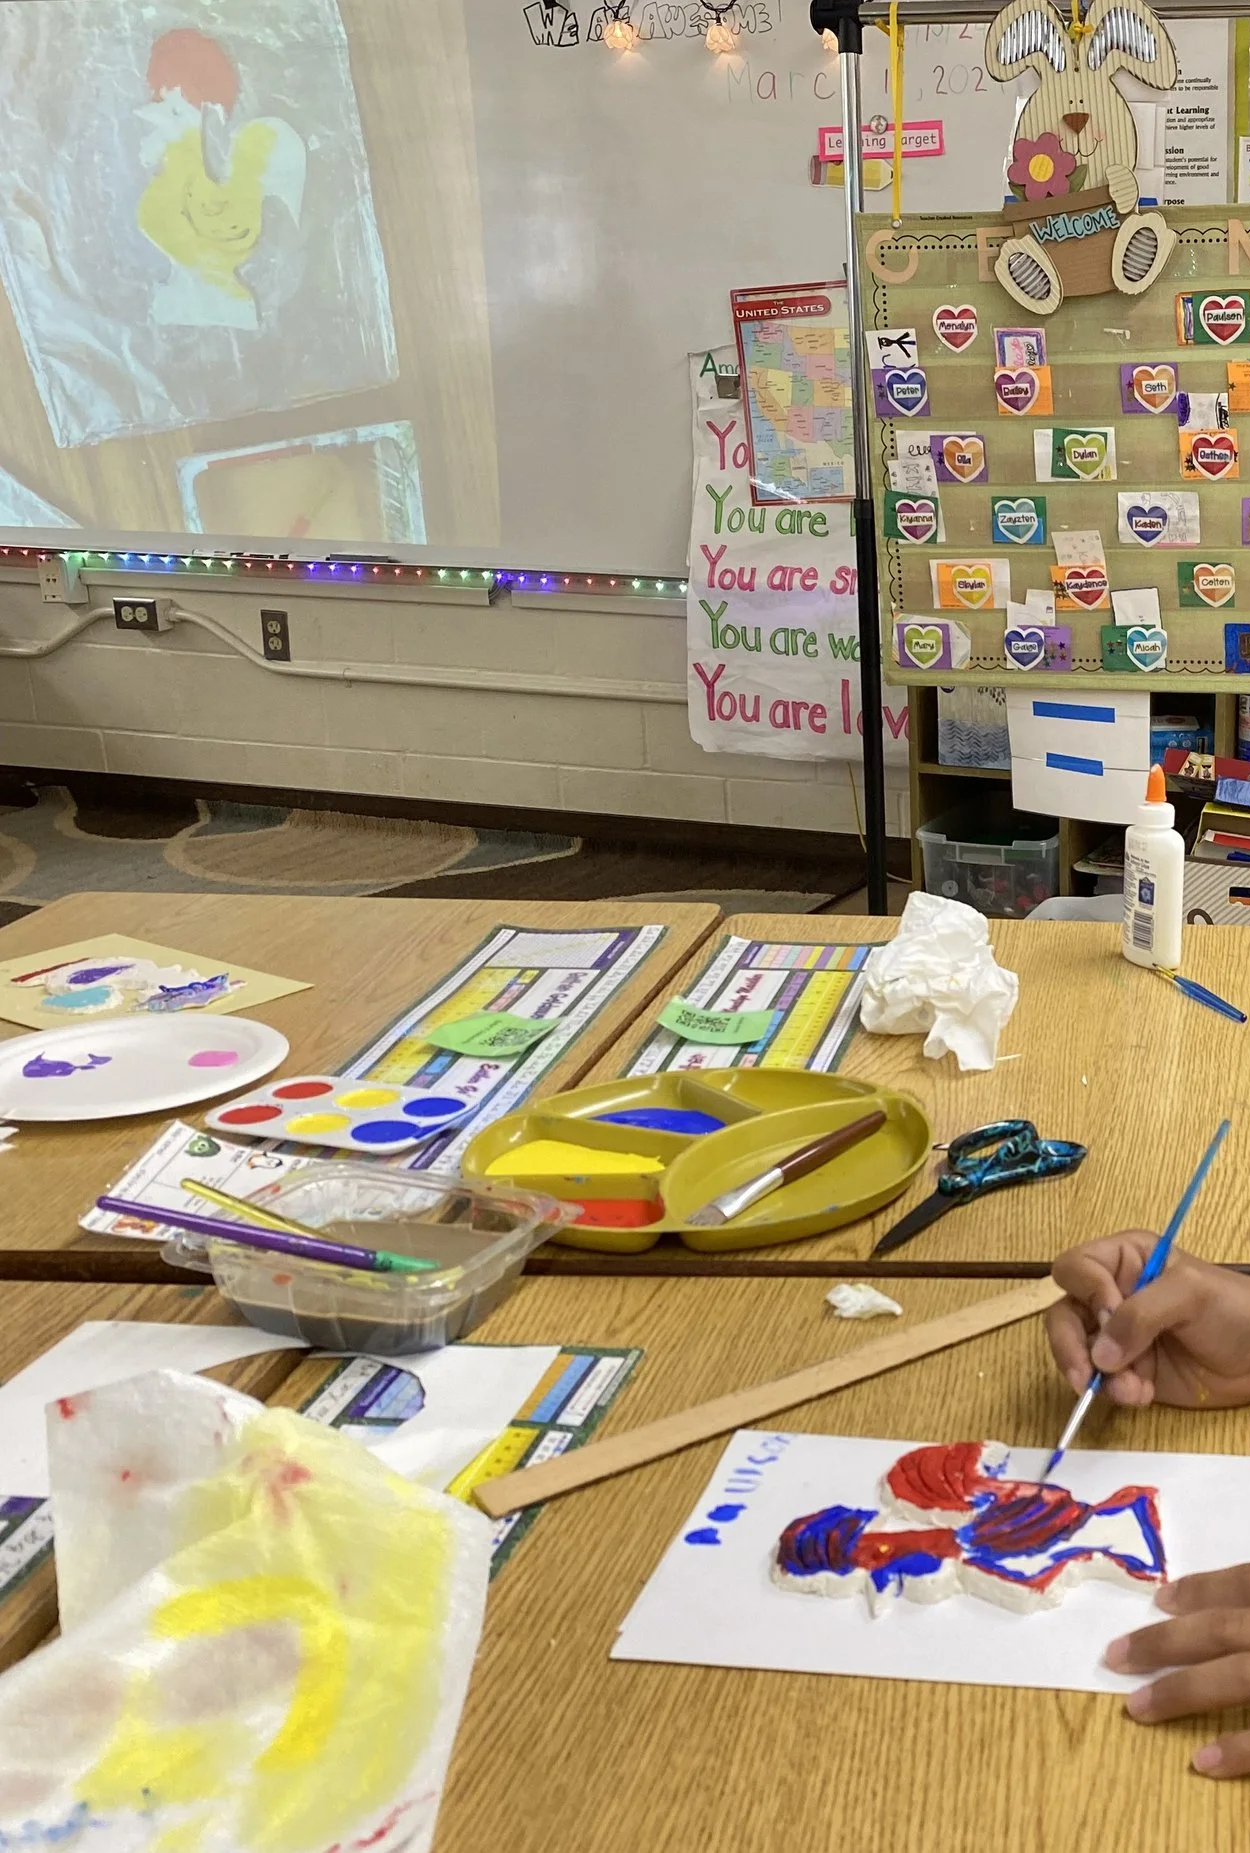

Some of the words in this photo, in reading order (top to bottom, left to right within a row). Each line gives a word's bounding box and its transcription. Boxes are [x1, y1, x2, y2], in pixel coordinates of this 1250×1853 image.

[727, 61, 836, 103] Marc
[932, 64, 1006, 96] 202
[1176, 106, 1209, 115] Learning
[828, 135, 887, 150] Leing
[900, 133, 938, 148] arget
[1032, 206, 1119, 241] WELCOME
[735, 307, 779, 318] UNITED
[780, 304, 824, 315] STATES
[1206, 311, 1243, 323] Paulson
[896, 386, 920, 396] Peter
[706, 420, 749, 470] Yo
[1073, 449, 1098, 460] Dylan
[705, 484, 766, 534] You
[775, 508, 829, 537] are
[1134, 519, 1161, 529] Kaden
[700, 544, 757, 592] You
[767, 565, 819, 592] are
[699, 599, 761, 652] You
[769, 627, 818, 658] are
[1135, 644, 1160, 652] Micah
[692, 662, 760, 722] You
[769, 699, 827, 734] are
